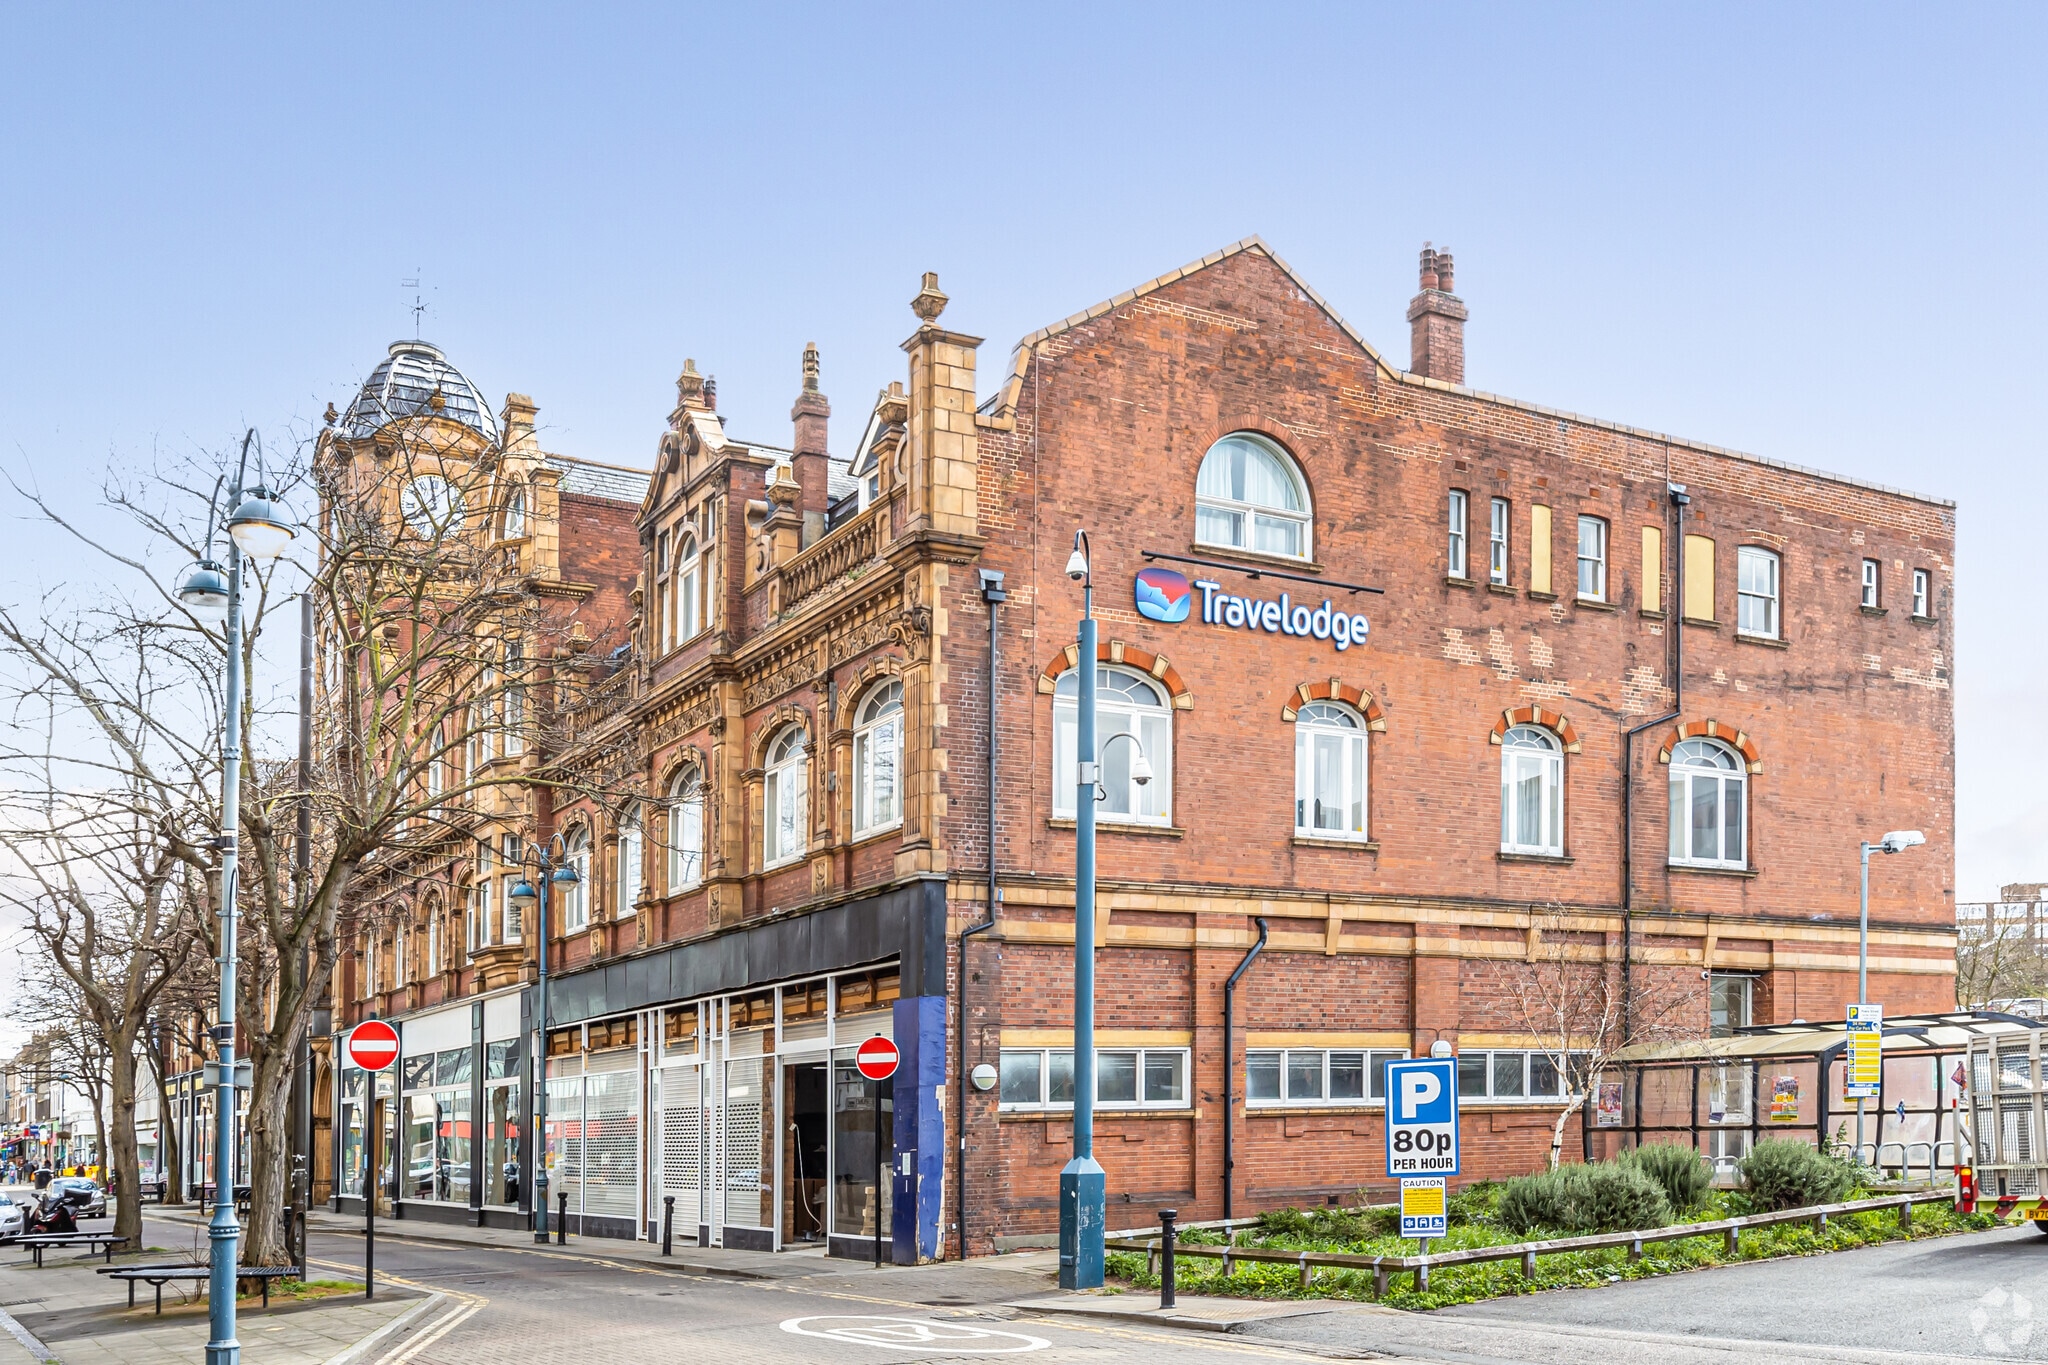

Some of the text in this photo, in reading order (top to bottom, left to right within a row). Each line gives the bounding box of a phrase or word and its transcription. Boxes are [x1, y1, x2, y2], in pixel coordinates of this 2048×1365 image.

[1194, 580, 1370, 651] Travelodge
[1401, 1071, 1441, 1119] P
[1393, 1129, 1451, 1156] 80p
[1393, 1157, 1453, 1170] PER HOUR
